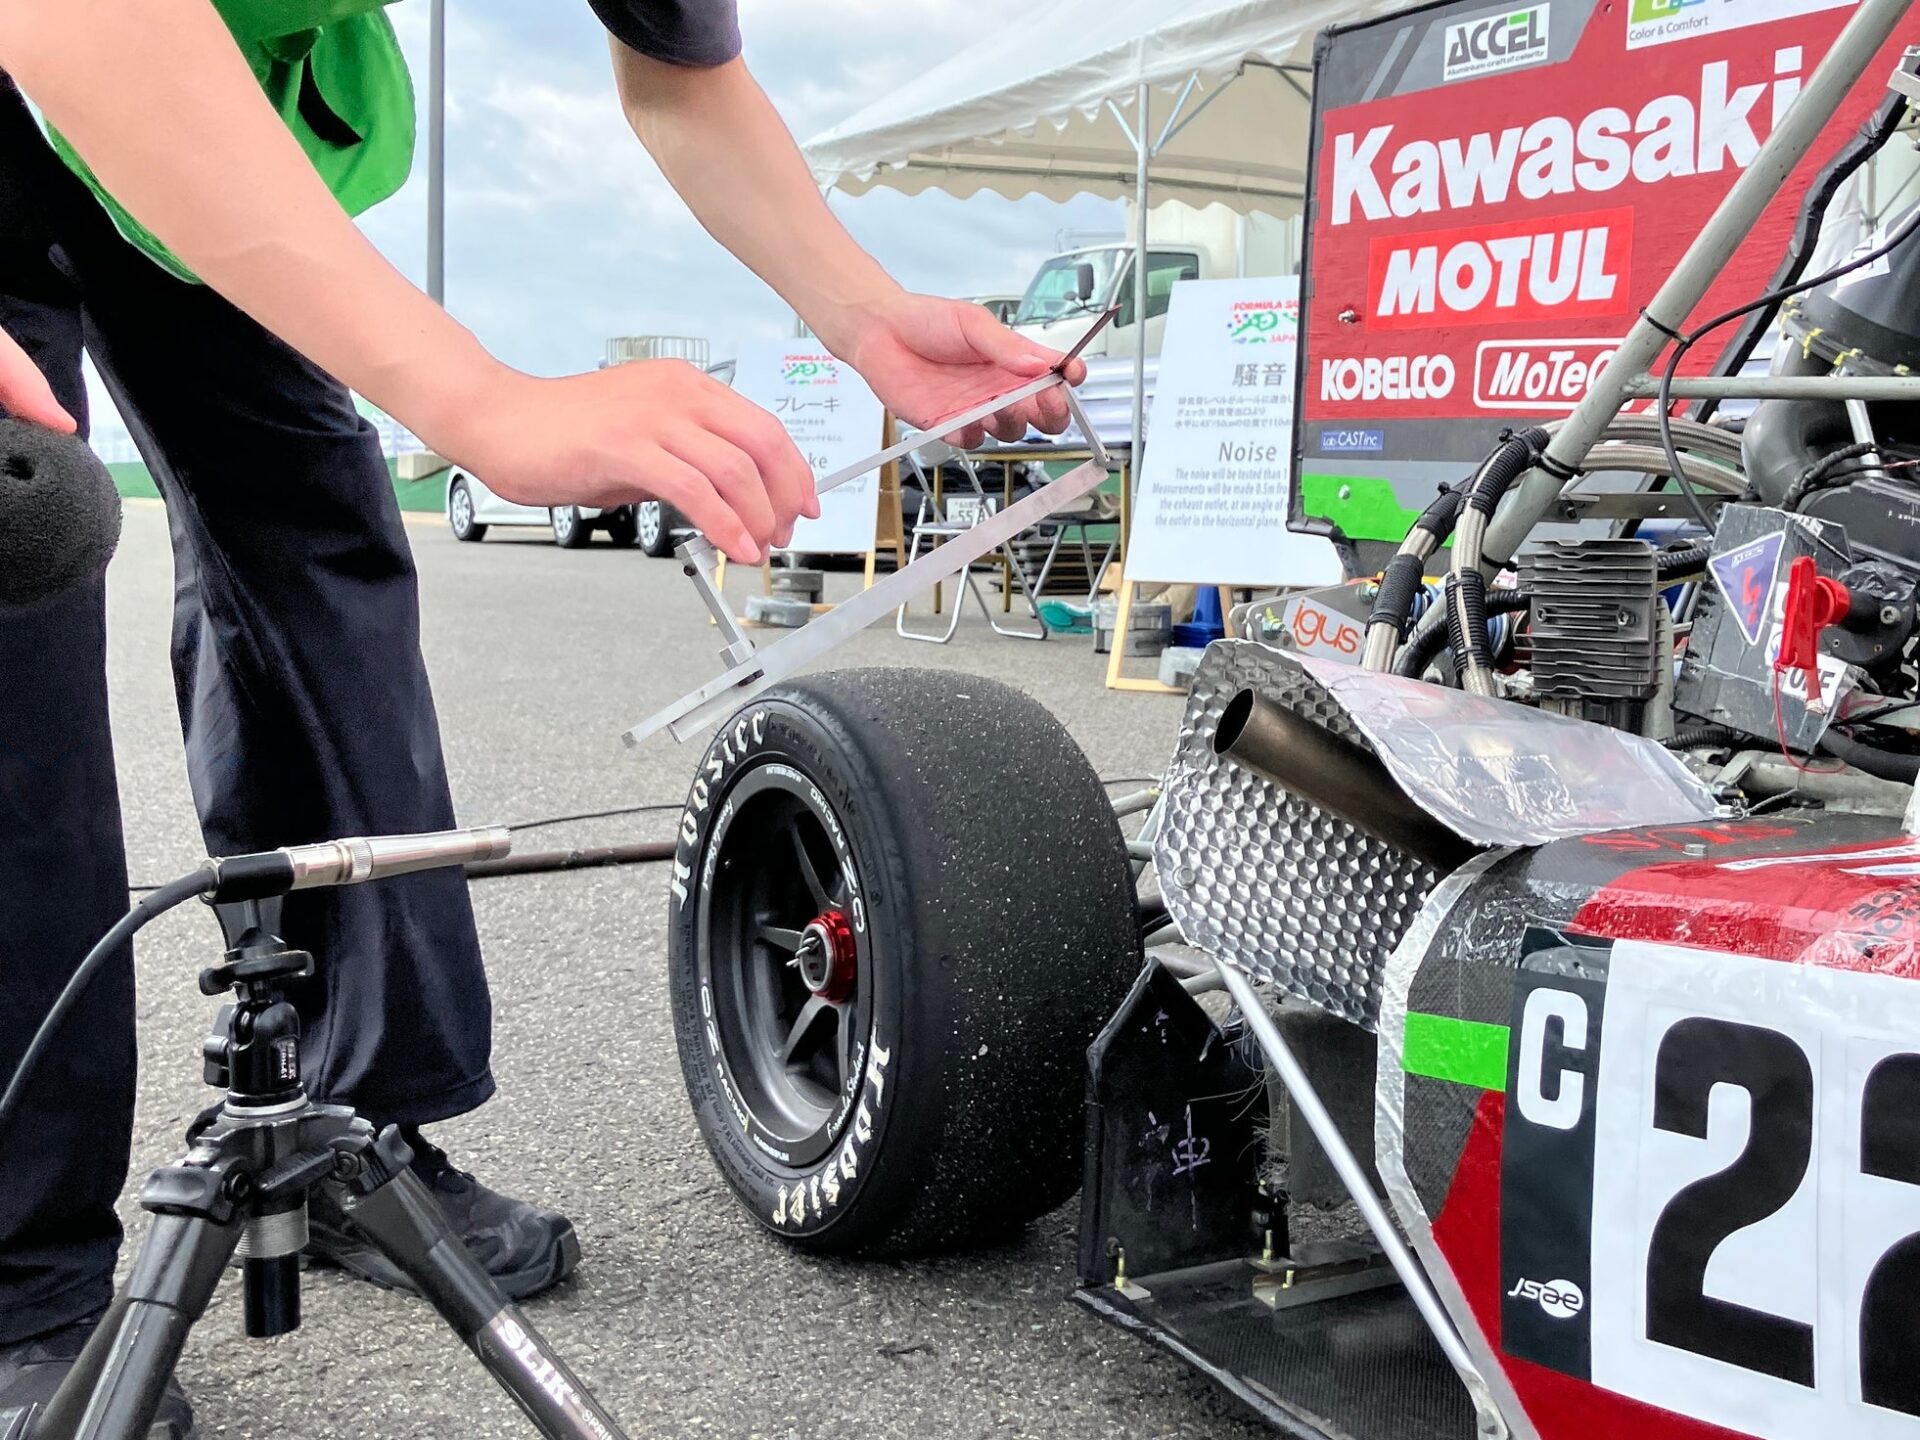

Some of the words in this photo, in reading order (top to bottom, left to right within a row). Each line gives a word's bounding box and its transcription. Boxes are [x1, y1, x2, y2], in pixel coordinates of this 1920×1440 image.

[1447, 10, 1546, 67] ACCEL
[1629, 27, 1655, 41] Color
[1657, 25, 1664, 36] &
[1666, 16, 1709, 33] Comfort
[1331, 45, 1802, 225] Kawasaki
[1376, 226, 1618, 316] MOTUL
[1270, 333, 1297, 343] JAPA
[1231, 363, 1287, 387] 騒音
[1321, 354, 1455, 401] KOBELCO
[775, 396, 841, 413] ブレーキ
[1218, 441, 1277, 462] Noise
[1176, 468, 1189, 481] The
[1190, 468, 1210, 481] noise
[1212, 467, 1226, 480] will
[1227, 467, 1237, 480] be
[1238, 467, 1262, 480] tested
[1263, 467, 1281, 480] than
[1152, 482, 1206, 495] Measurements
[1207, 482, 1221, 495] will
[1222, 482, 1231, 495] be
[1233, 482, 1255, 495] made
[1276, 482, 1288, 495] fro
[1160, 497, 1172, 511] the
[1174, 498, 1203, 511] exhaust
[1230, 498, 1239, 511] at
[1240, 500, 1251, 511] an
[1252, 498, 1273, 513] angle
[1274, 498, 1284, 511] of
[1155, 513, 1167, 527] the
[1169, 514, 1192, 527] outlet
[1193, 514, 1201, 526] in
[1202, 513, 1215, 527] the
[1215, 514, 1256, 528] horizontal
[1293, 599, 1359, 653] igus
[1789, 668, 1836, 691] OF
[809, 787, 845, 850] RACING
[1517, 988, 1588, 1131] C
[716, 1062, 748, 1127] RACING
[497, 1318, 575, 1407] SLIK
[581, 1408, 613, 1440] SPRI
